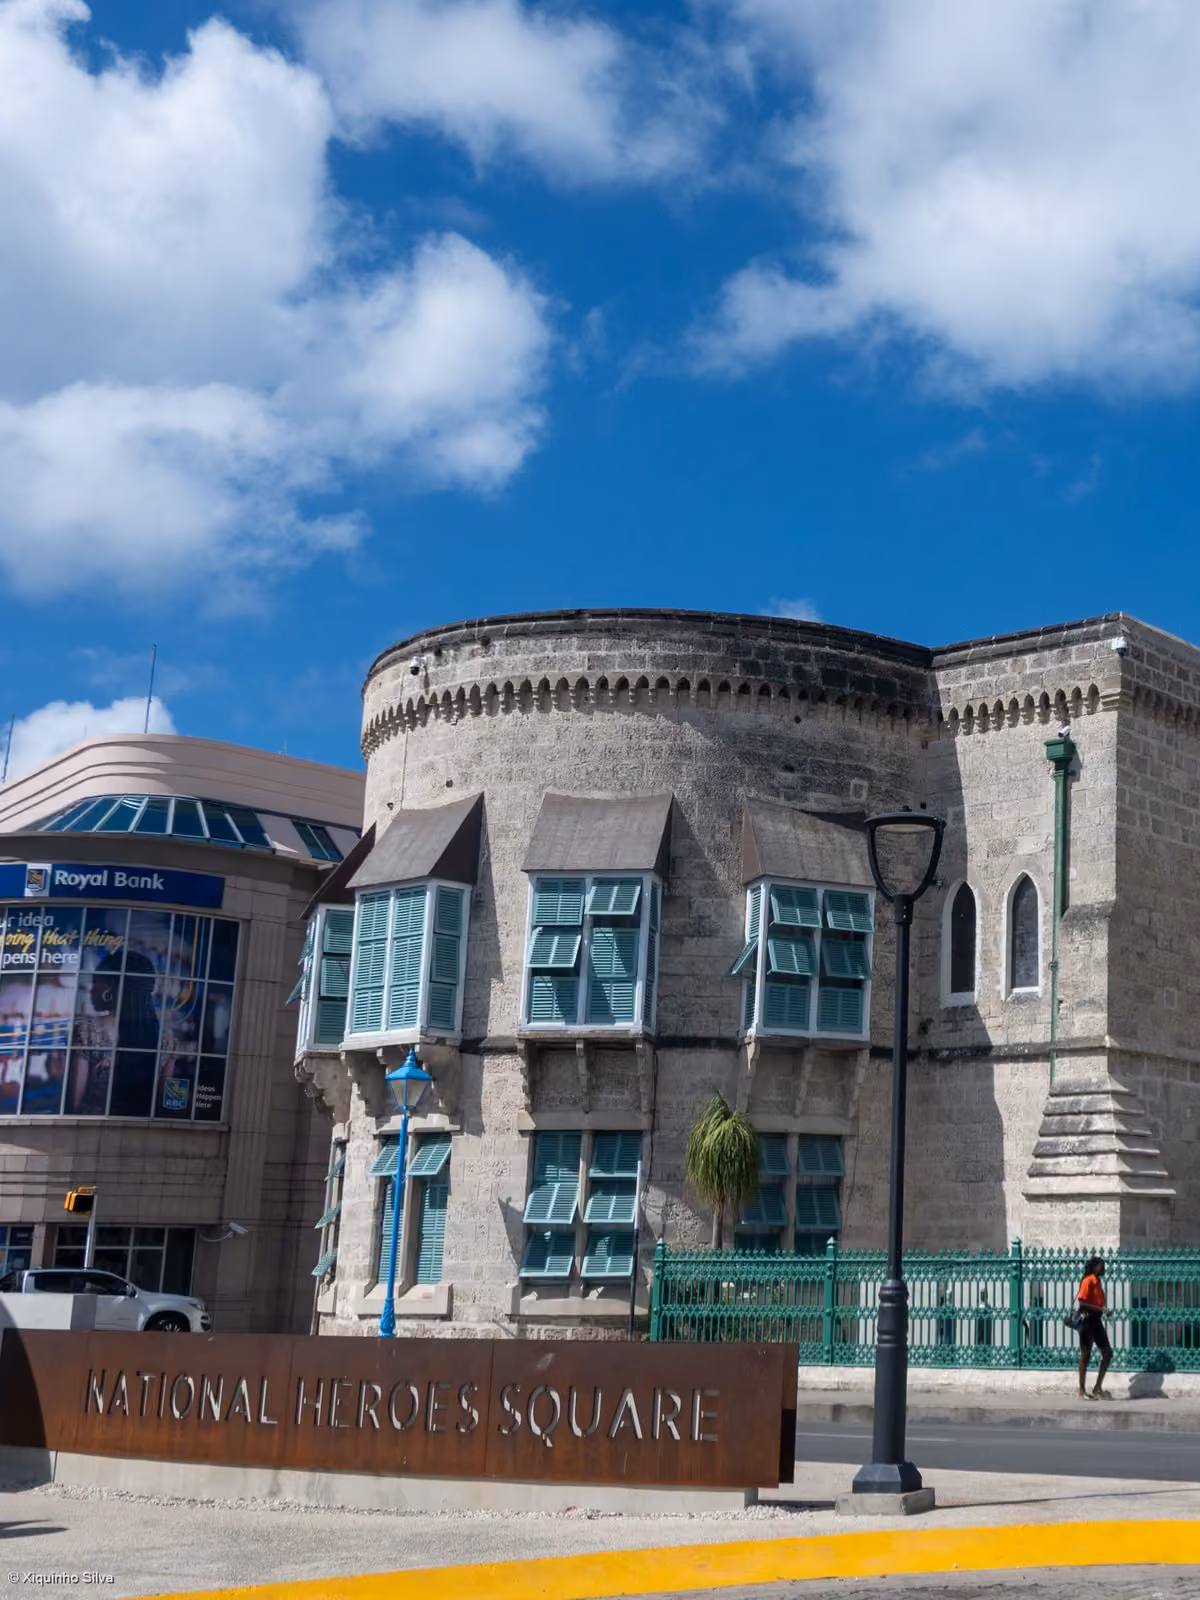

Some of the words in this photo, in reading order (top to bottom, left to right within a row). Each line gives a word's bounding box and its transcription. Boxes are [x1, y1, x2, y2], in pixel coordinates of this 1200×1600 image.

[55, 870, 108, 890] Royal
[114, 872, 165, 890] Bank
[18, 912, 54, 927] idea
[41, 947, 79, 964] here
[85, 1368, 278, 1425] NATIONAL
[294, 1376, 479, 1433] HEROES
[498, 1383, 721, 1448] SQUARE
